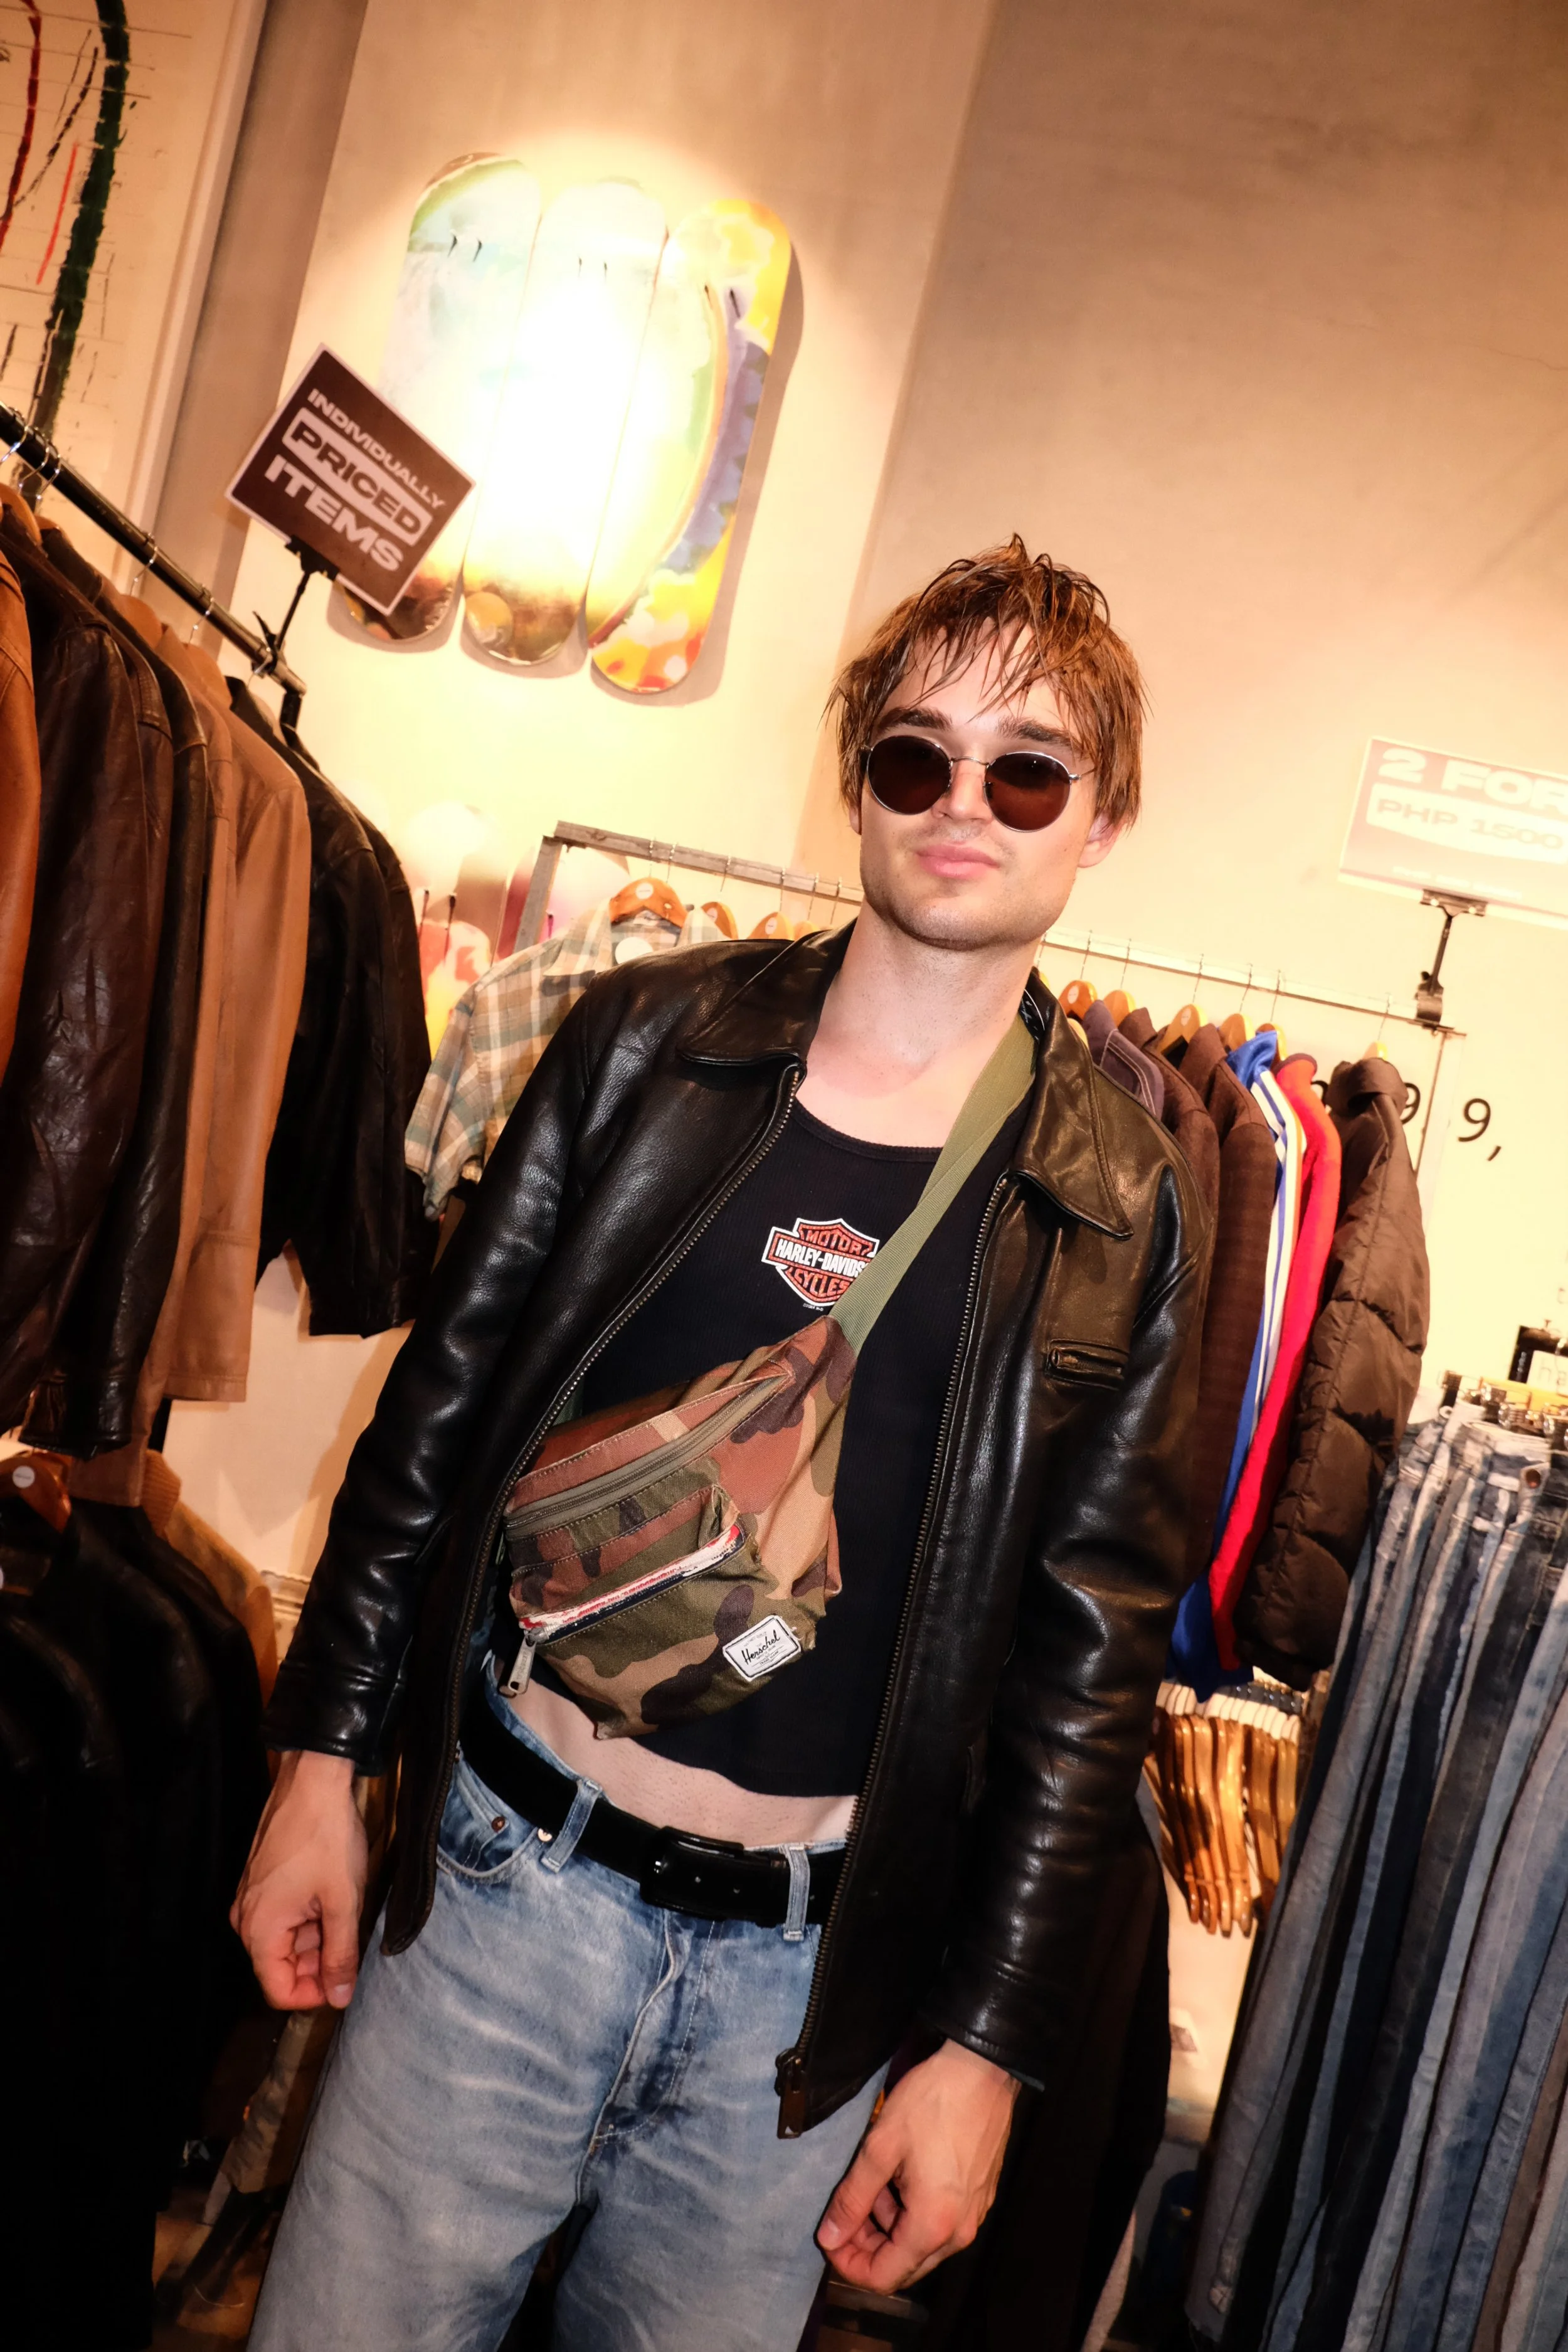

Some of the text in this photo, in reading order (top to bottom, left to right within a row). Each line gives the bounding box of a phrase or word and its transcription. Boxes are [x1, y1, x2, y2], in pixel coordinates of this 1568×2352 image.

[307, 388, 447, 510] INDIVIDUALLY
[290, 420, 422, 536] PRICED
[264, 454, 404, 572] ITEMS
[1378, 747, 1568, 816] 2 FOR
[1377, 798, 1563, 850] PHP 1500
[775, 1238, 869, 1278] HARLEY-DAVIDS
[806, 1229, 862, 1254] MOTOR
[794, 1267, 850, 1298] CYCLES
[741, 1629, 780, 1665] Herschel
